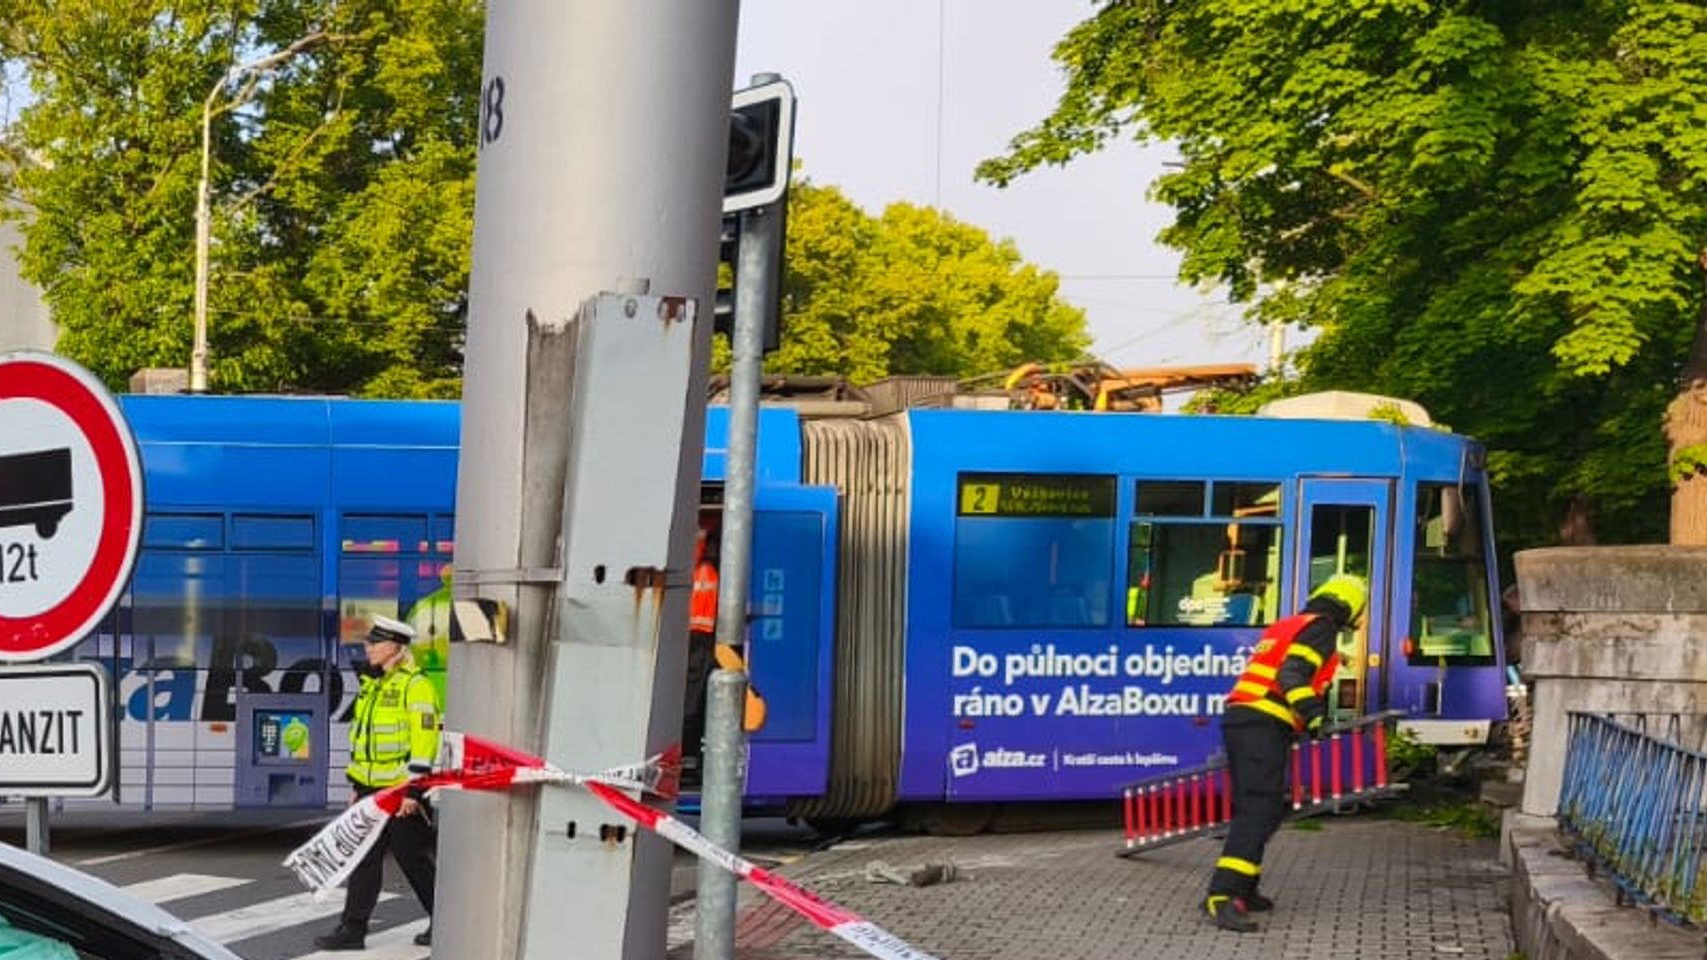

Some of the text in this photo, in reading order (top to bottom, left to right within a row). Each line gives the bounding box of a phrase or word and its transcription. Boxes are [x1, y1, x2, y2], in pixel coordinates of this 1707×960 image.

[973, 486, 987, 511] 2
[952, 645, 1255, 685] Do půlnoci objedná
[953, 686, 1023, 716] ráno
[1030, 694, 1051, 716] v
[1055, 685, 1199, 716] AlzaBoxu
[982, 747, 1046, 767] alza.cz
